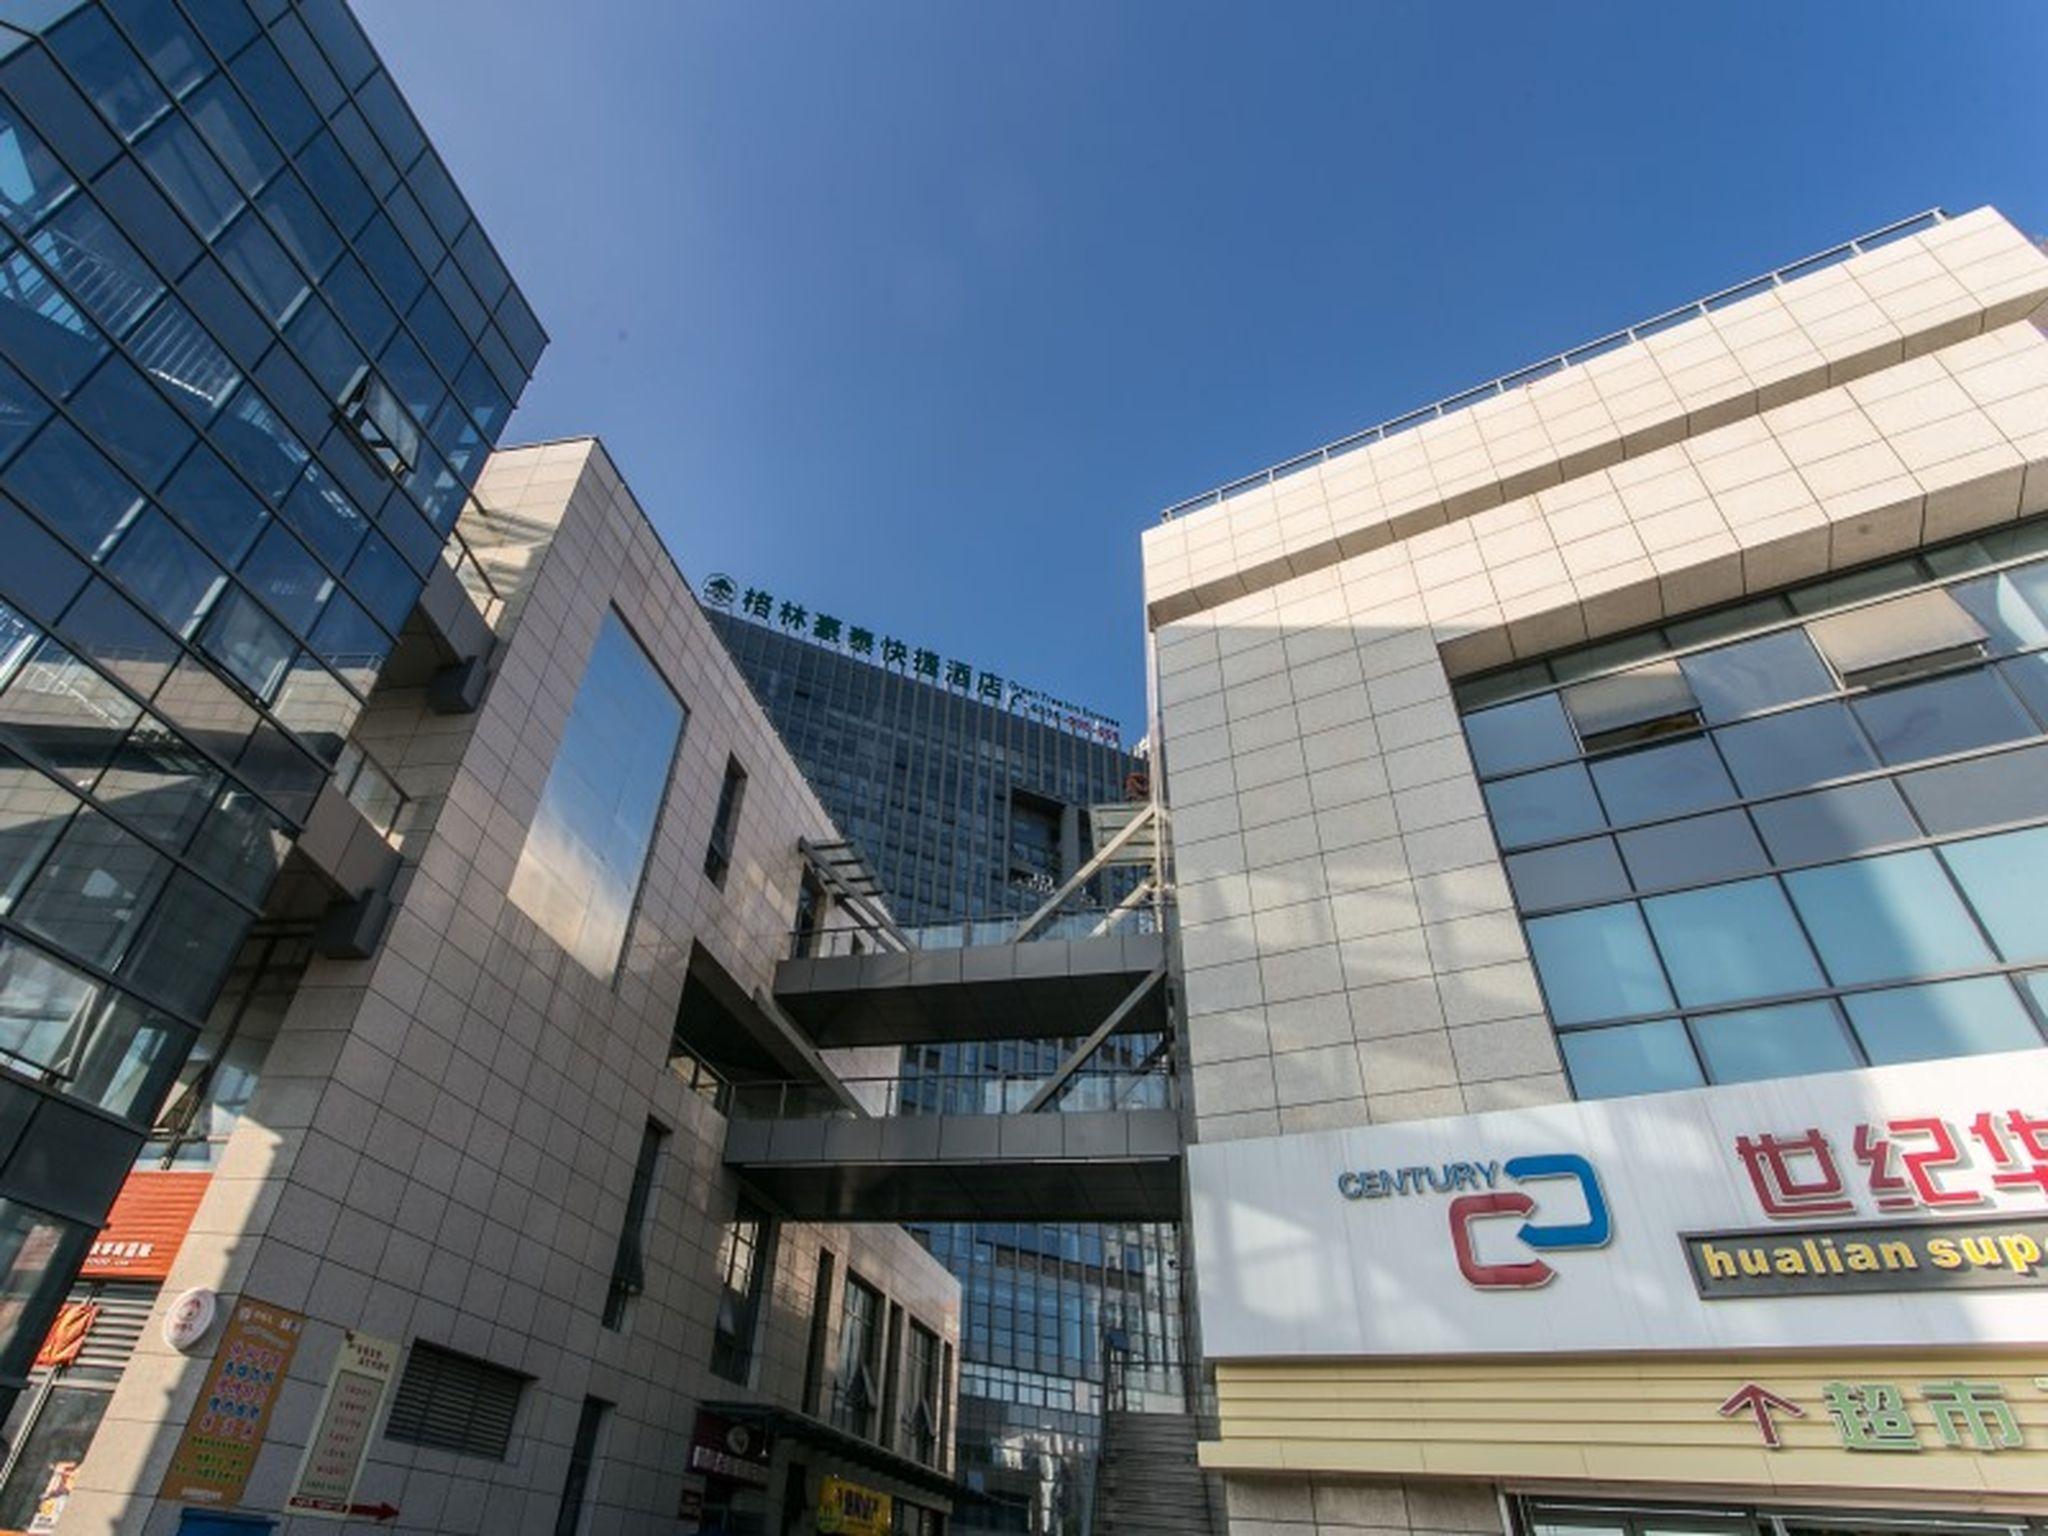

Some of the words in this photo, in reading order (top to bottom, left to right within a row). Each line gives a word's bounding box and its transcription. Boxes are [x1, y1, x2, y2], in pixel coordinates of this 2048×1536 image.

[742, 587, 1004, 700] 格林豪泰快捷酒店
[1338, 1160, 1500, 1200] CENTURY
[1702, 1238, 1919, 1280] hualian
[1927, 1232, 2048, 1274] sup
[1823, 1377, 2048, 1455] 超市
